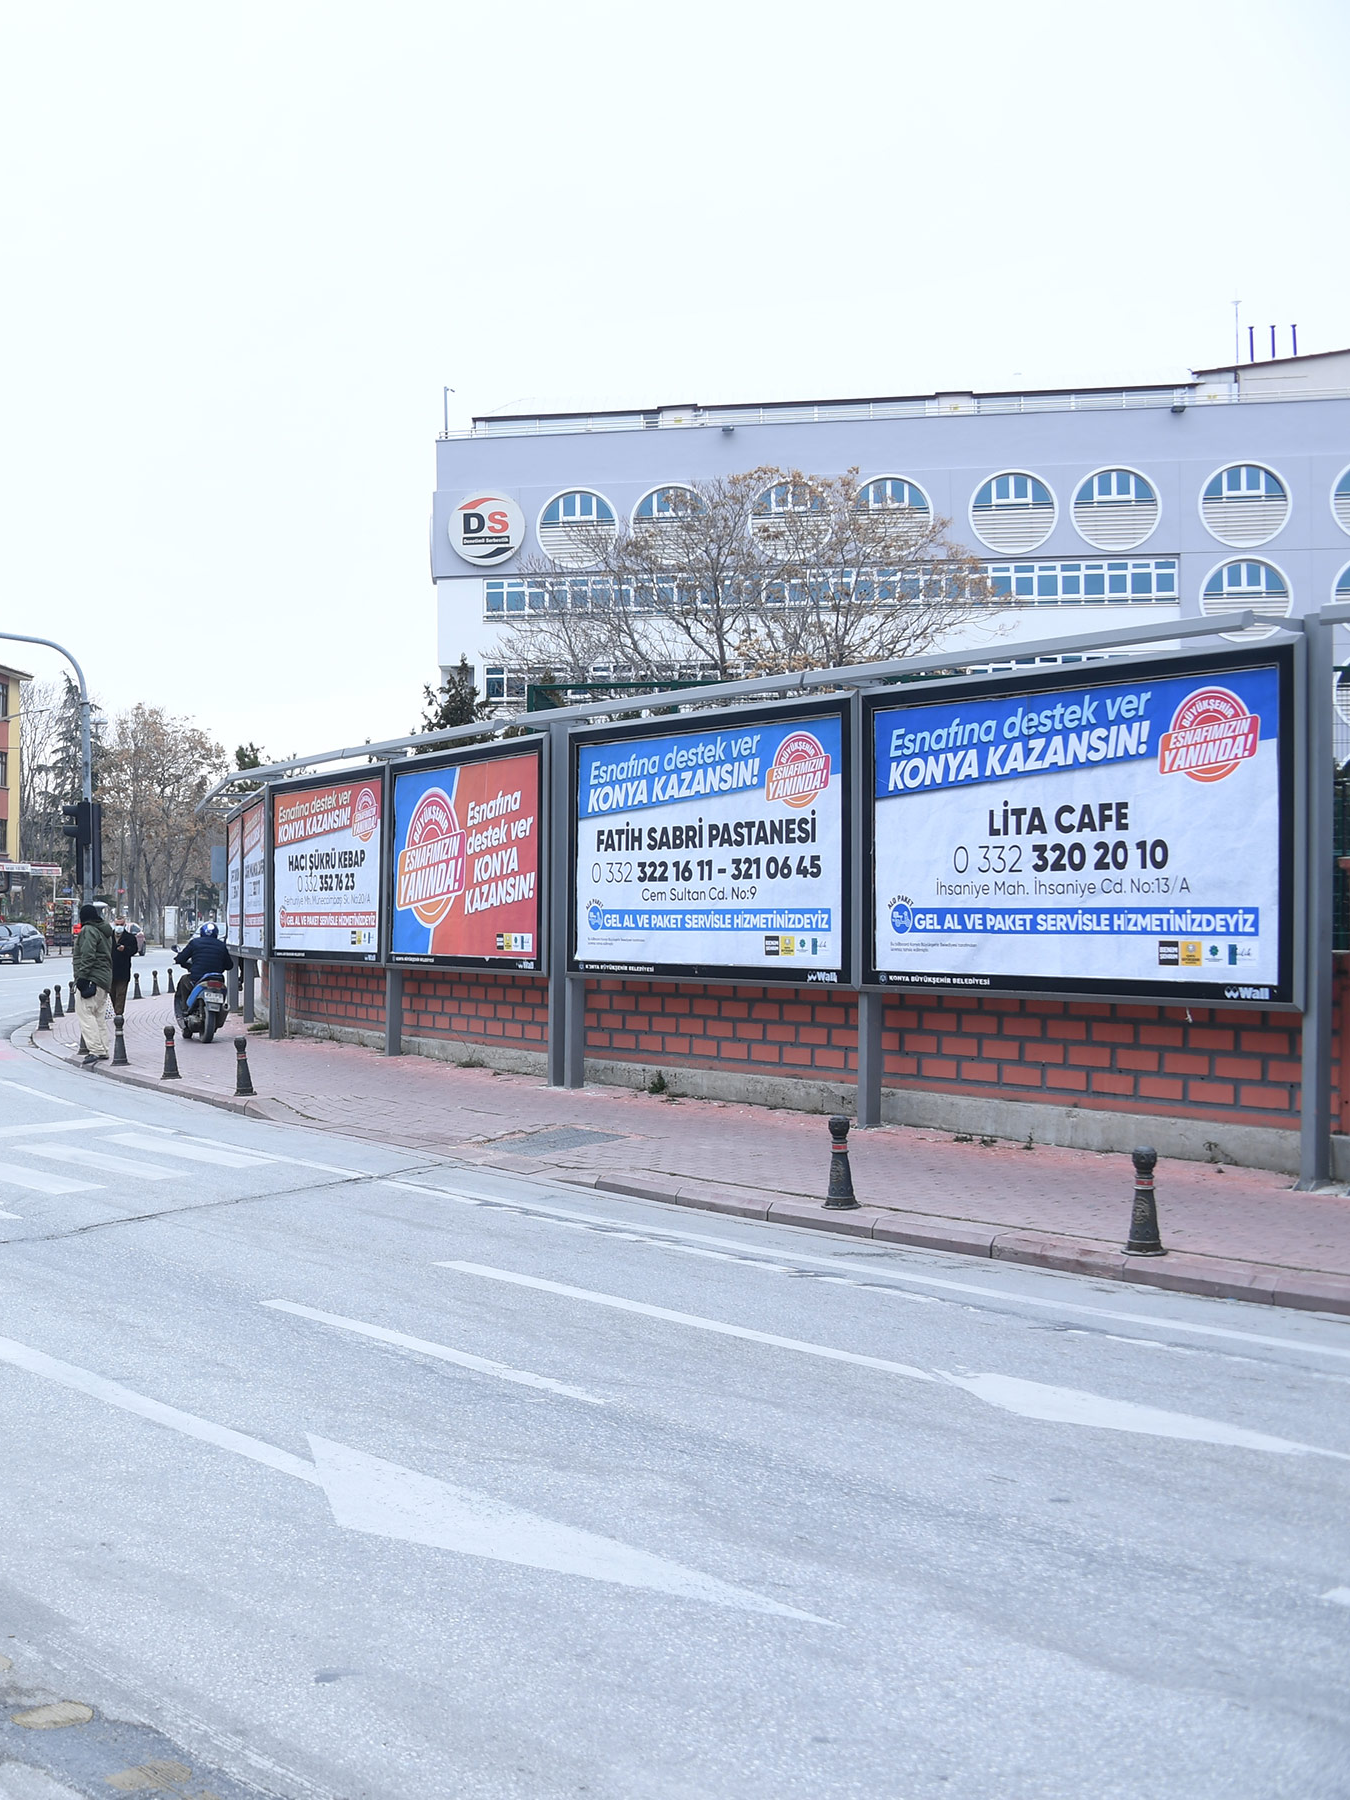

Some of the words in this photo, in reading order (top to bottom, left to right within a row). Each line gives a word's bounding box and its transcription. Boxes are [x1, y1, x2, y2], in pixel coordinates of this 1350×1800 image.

[463, 511, 510, 535] DS
[889, 717, 997, 758] Esnafına
[1002, 695, 1100, 740] destek
[1105, 690, 1152, 722] ver
[1181, 698, 1235, 728] BÜYÜKŞEHİR
[1169, 717, 1252, 749] ESNAFIMIZIN
[589, 753, 661, 786] Esnafına
[663, 736, 727, 771] destek
[731, 734, 761, 758] ver
[772, 757, 826, 780] ESNAFIMIZIN
[888, 748, 979, 792] KONYA
[984, 720, 1151, 777] KAZANSIN!
[1163, 733, 1254, 773] YANINDA!
[587, 779, 648, 813] KONYA
[651, 758, 760, 802] KAZANSIN!
[768, 769, 827, 800] YANINDA!
[278, 801, 309, 823] Esnafına
[311, 791, 337, 814] destek
[338, 790, 351, 806] ver
[467, 790, 521, 827] Esnafına
[988, 800, 1048, 837] LİTA
[1054, 801, 1130, 834] CAFE
[278, 819, 304, 843] KONYA
[305, 806, 351, 835] KAZANSIN!
[466, 819, 508, 855] destek
[510, 816, 533, 840] ver
[596, 821, 643, 852] FATİH
[646, 816, 703, 850] SABRİ
[708, 809, 816, 847] PASTANESİ
[288, 853, 308, 871] HACI
[309, 848, 336, 875] ŞÜKRÜ
[338, 849, 366, 869] KEBAP
[404, 835, 460, 872] ESNAFIMIZIN
[473, 847, 519, 884] KONYA
[592, 862, 601, 883] 0
[606, 861, 633, 882] 332
[637, 861, 669, 882] 322
[672, 860, 693, 882] 16
[697, 859, 713, 881] 11
[731, 857, 760, 881] 321
[765, 856, 792, 879] 06
[796, 855, 822, 878] 45
[953, 846, 969, 873] 0
[977, 845, 1023, 873] 332
[1031, 842, 1087, 872] 320
[1093, 840, 1129, 871] 20
[1135, 839, 1169, 870] 10
[305, 875, 318, 892] 332
[319, 874, 333, 891] 352
[335, 873, 343, 891] 76
[345, 873, 355, 890] 23
[400, 858, 462, 905] YANINDA!
[464, 872, 535, 915] KAZANSIN!
[641, 888, 667, 901] Cem
[670, 887, 706, 901] Sultan
[709, 887, 728, 900] Cd.
[731, 886, 757, 900] No:9
[936, 878, 990, 899] İhsaniye
[994, 880, 1029, 895] Mah.
[1034, 877, 1096, 898] İhsaniye
[1100, 878, 1127, 894] Cd.
[1130, 877, 1191, 894] No:13/A
[295, 915, 300, 925] AL
[301, 915, 307, 925] VE
[307, 915, 319, 925] PAKET
[604, 914, 622, 928] GEL
[623, 914, 635, 928] AL
[637, 914, 649, 928] VE
[651, 914, 683, 929] PAKET
[684, 911, 732, 929] SERVİSLE
[733, 910, 829, 929] HİZMETİNİZDEYİZ
[914, 914, 941, 930] GEL
[943, 914, 962, 930] AL
[963, 914, 983, 930] VE
[986, 914, 1033, 931] PAKET
[1036, 909, 1110, 931] SERVİSLE
[1113, 909, 1256, 932] HİZMETİNİZDEYİZ
[911, 975, 951, 985] BÜYÜKŞEHİR
[952, 977, 990, 986] BELEDİYESİ
[1238, 986, 1270, 1000] Wall
